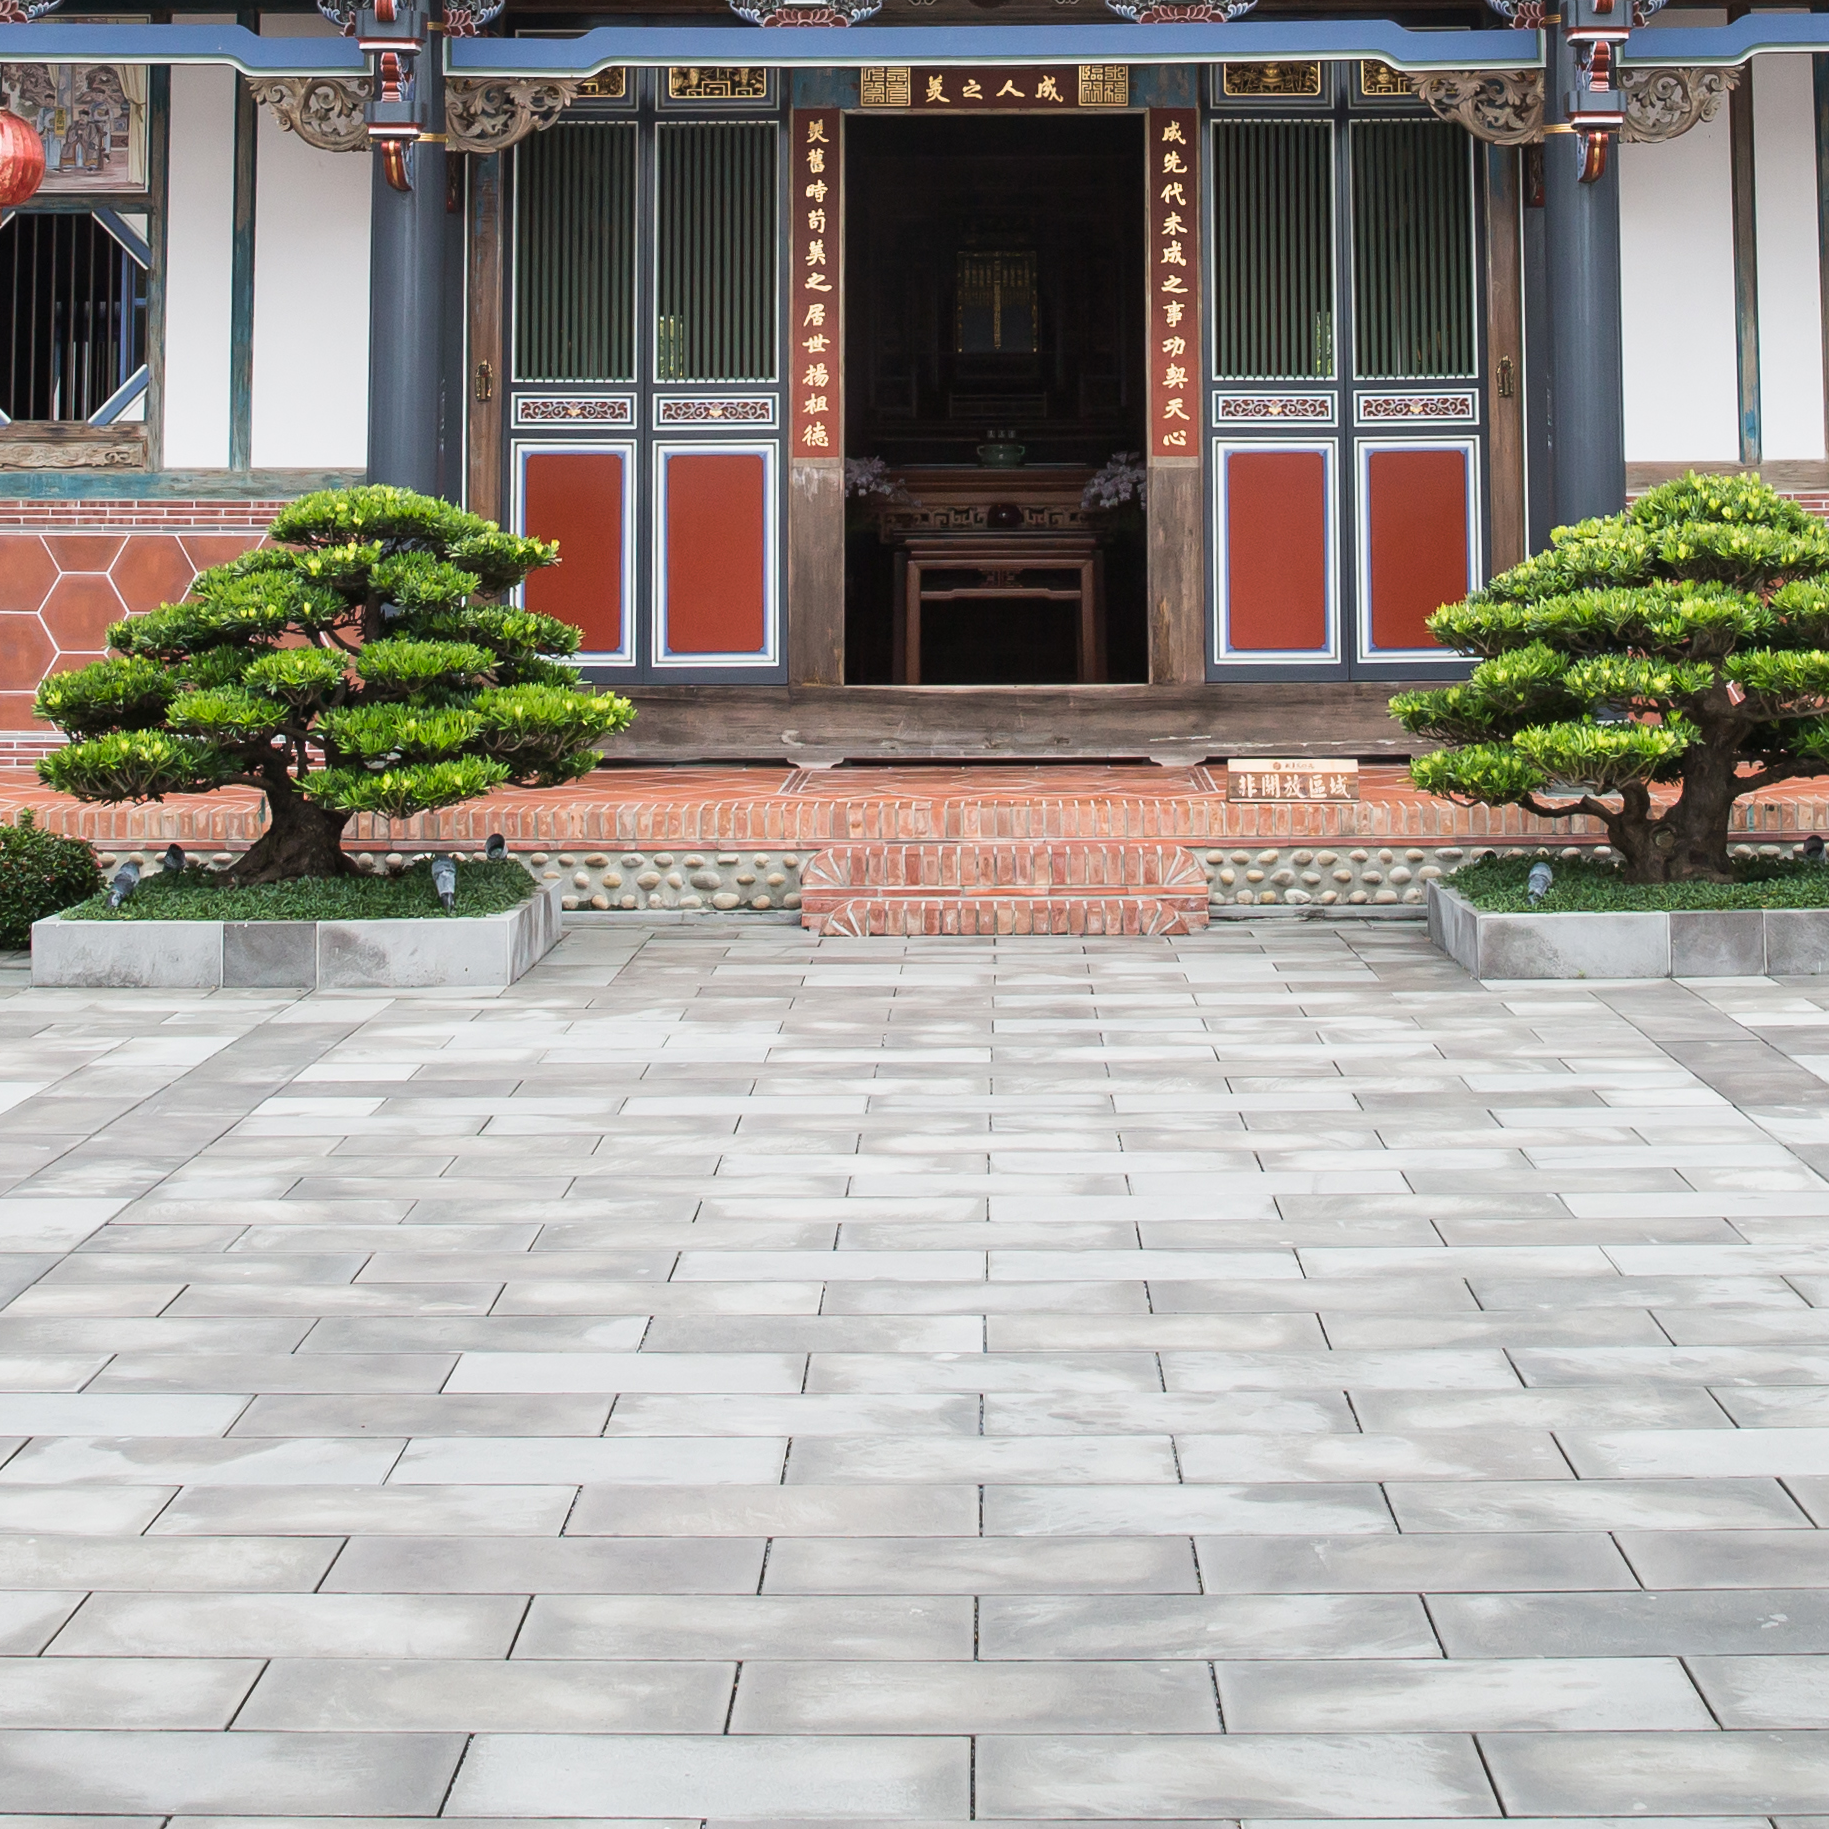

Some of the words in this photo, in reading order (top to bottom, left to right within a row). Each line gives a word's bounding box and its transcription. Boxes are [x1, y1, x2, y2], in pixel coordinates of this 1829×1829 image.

[926, 74, 1064, 103] 成人之美
[1160, 120, 1191, 447] 成先代未成之事功契天心
[1238, 773, 1351, 799] 非開放區域
